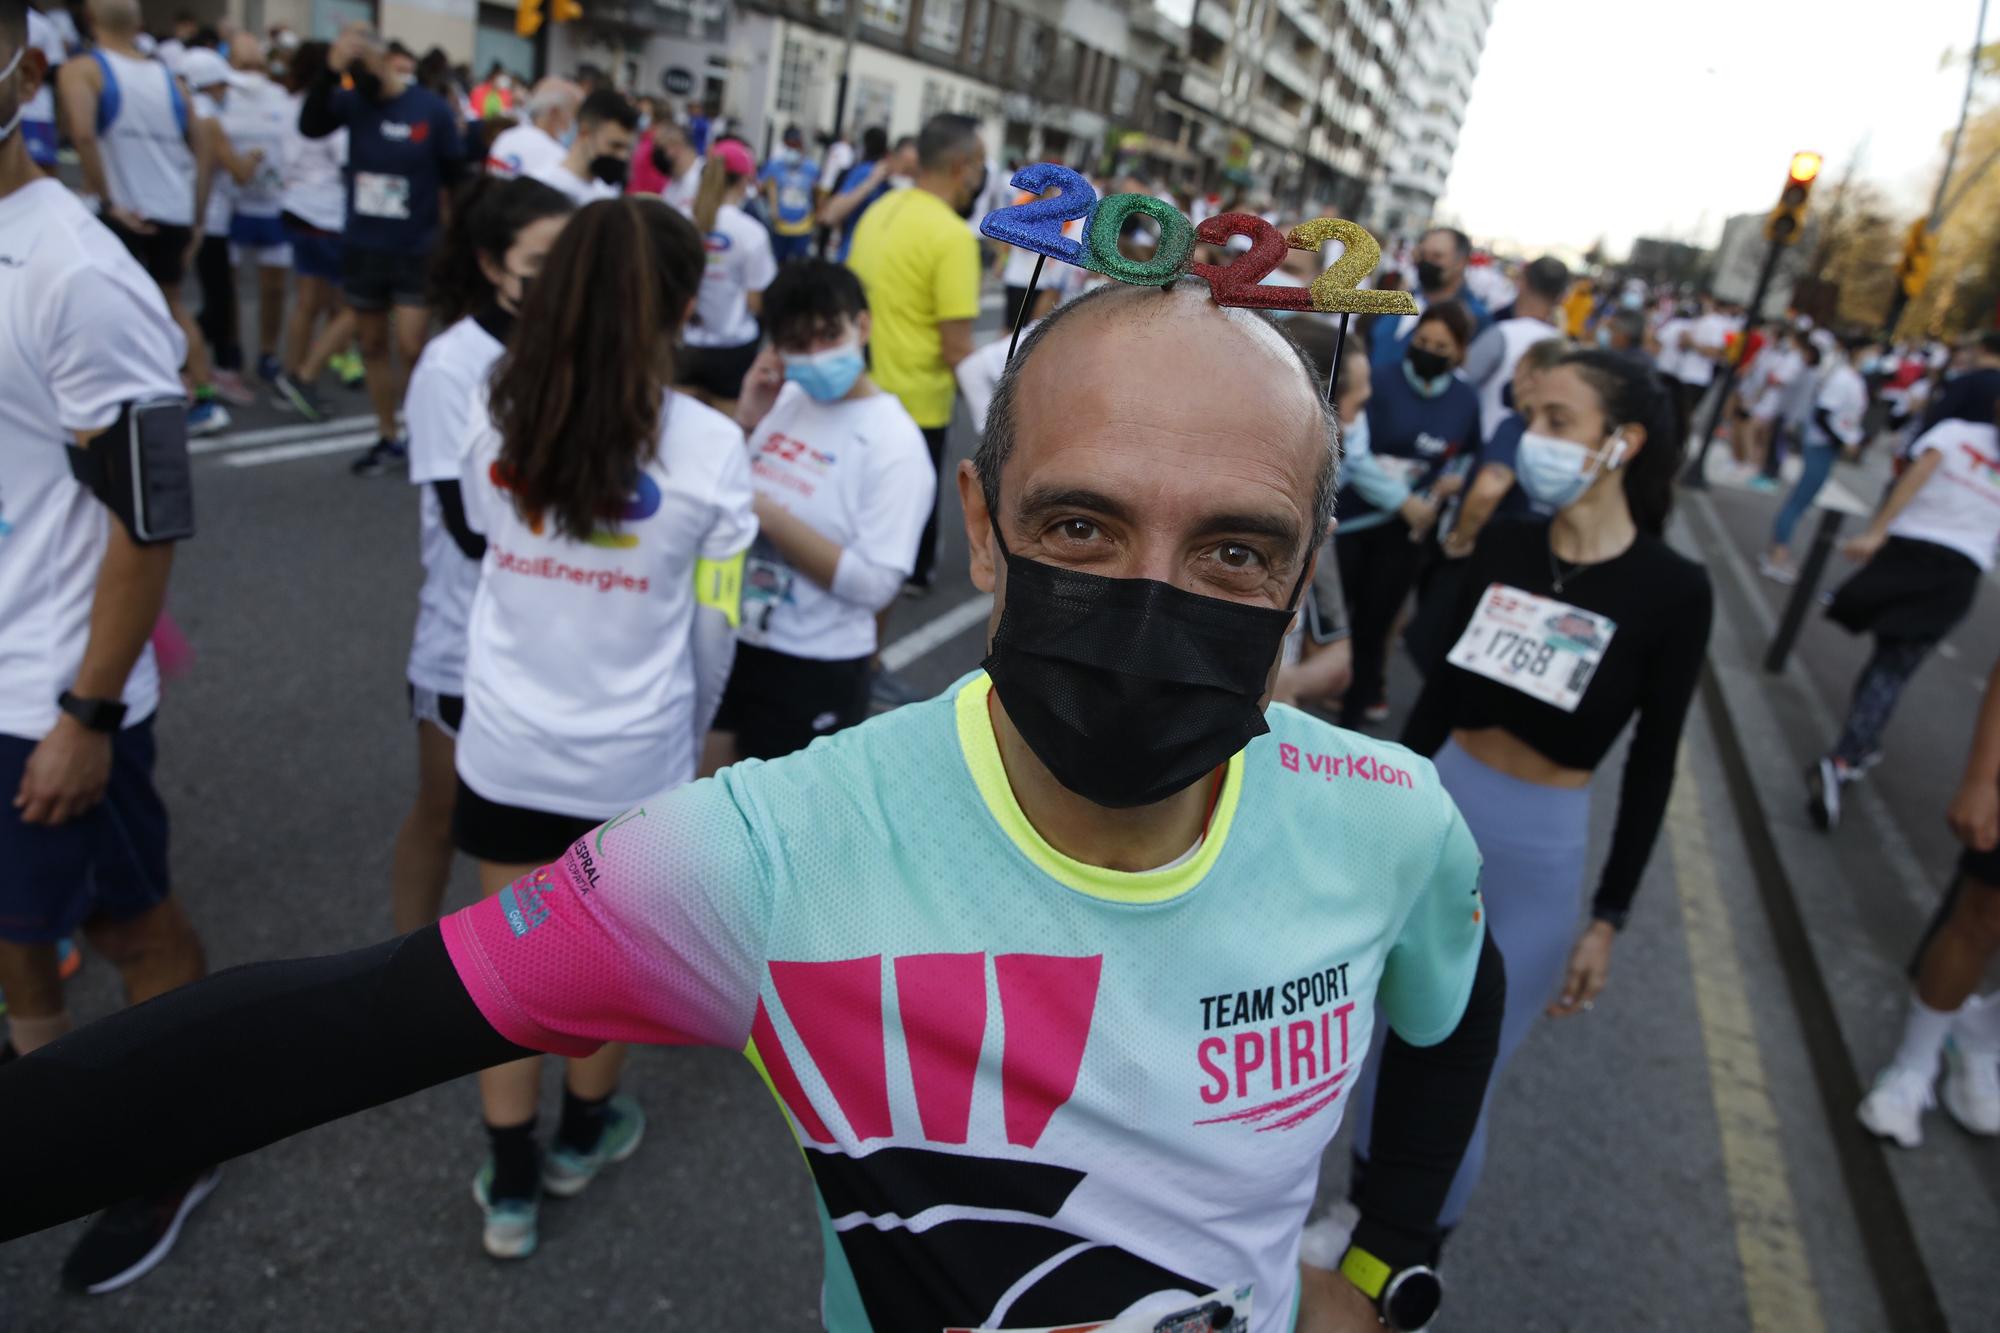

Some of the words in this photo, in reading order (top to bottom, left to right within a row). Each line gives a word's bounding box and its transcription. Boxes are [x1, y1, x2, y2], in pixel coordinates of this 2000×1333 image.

[979, 162, 1419, 316] 2022
[1485, 629, 1556, 677] 1768
[1199, 986, 1275, 1031] TEAM
[1281, 962, 1350, 1016] SPORT
[1197, 1001, 1356, 1105] SPIRIT
